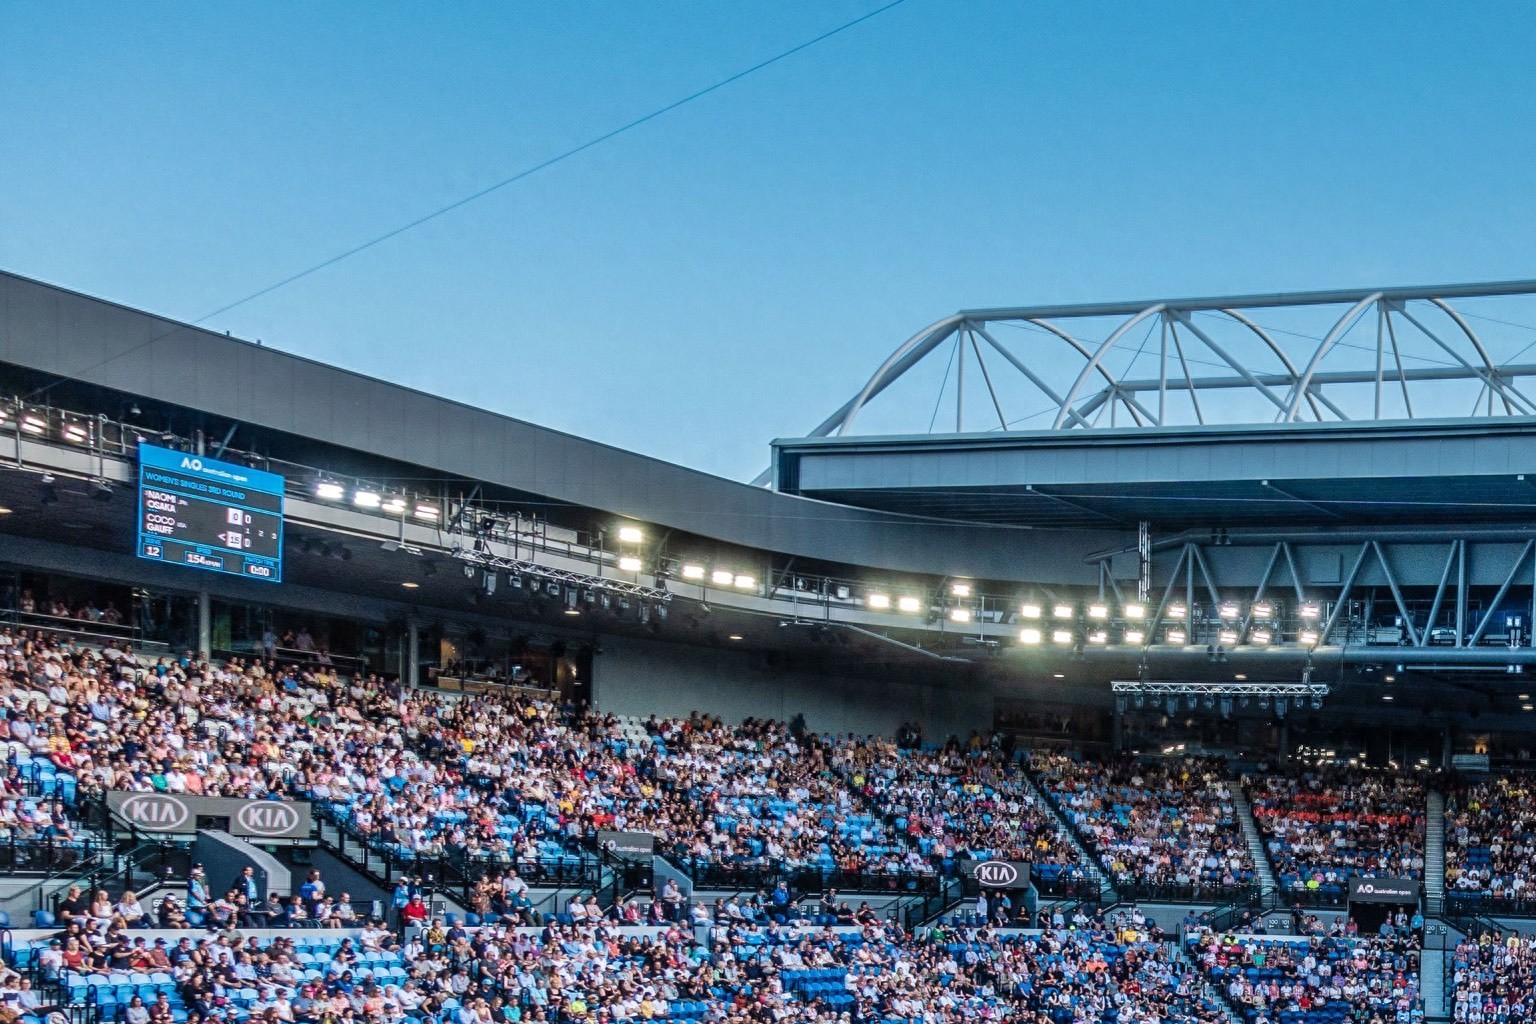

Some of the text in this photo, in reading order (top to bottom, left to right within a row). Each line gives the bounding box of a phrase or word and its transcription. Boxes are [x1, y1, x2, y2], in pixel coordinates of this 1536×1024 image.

[180, 457, 202, 471] AO
[148, 490, 176, 503] NAOMI
[147, 500, 176, 513] OSAKA
[147, 514, 175, 526] COCO
[147, 522, 174, 534] GAUFF
[146, 546, 160, 556] 12
[132, 801, 176, 822] KIA
[249, 808, 288, 828] KIA
[982, 866, 1010, 880] KIA
[1358, 884, 1373, 893] AO
